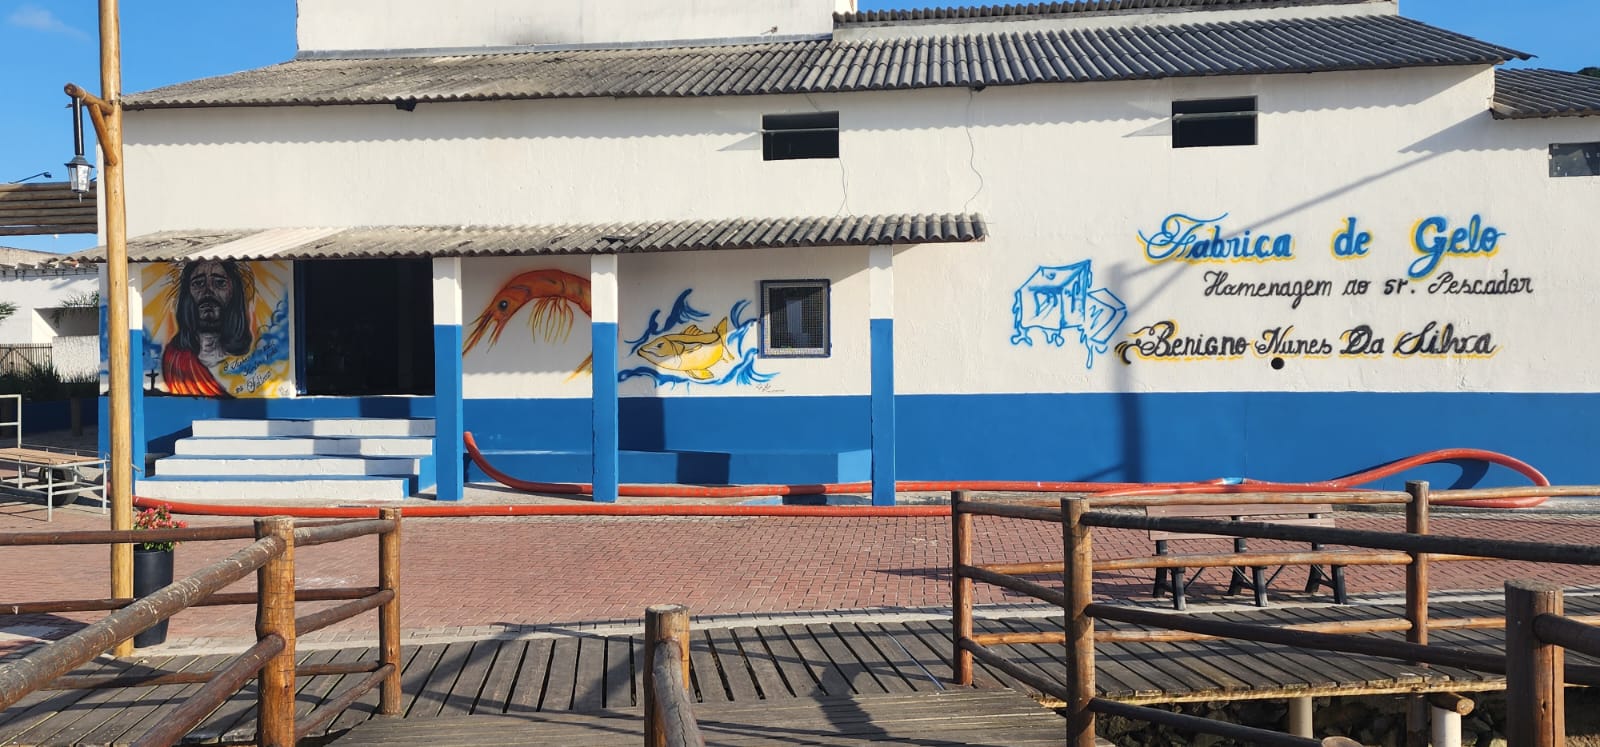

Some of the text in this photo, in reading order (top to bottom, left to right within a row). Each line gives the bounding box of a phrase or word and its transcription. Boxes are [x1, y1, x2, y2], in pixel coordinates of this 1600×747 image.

[1138, 212, 1505, 277] Fabrica de Gelo
[1203, 269, 1533, 309] Homenagem ao sr. Pescador
[1255, 325, 1332, 354] Nunes
[1339, 324, 1384, 354] Da
[1393, 321, 1497, 355] Silva
